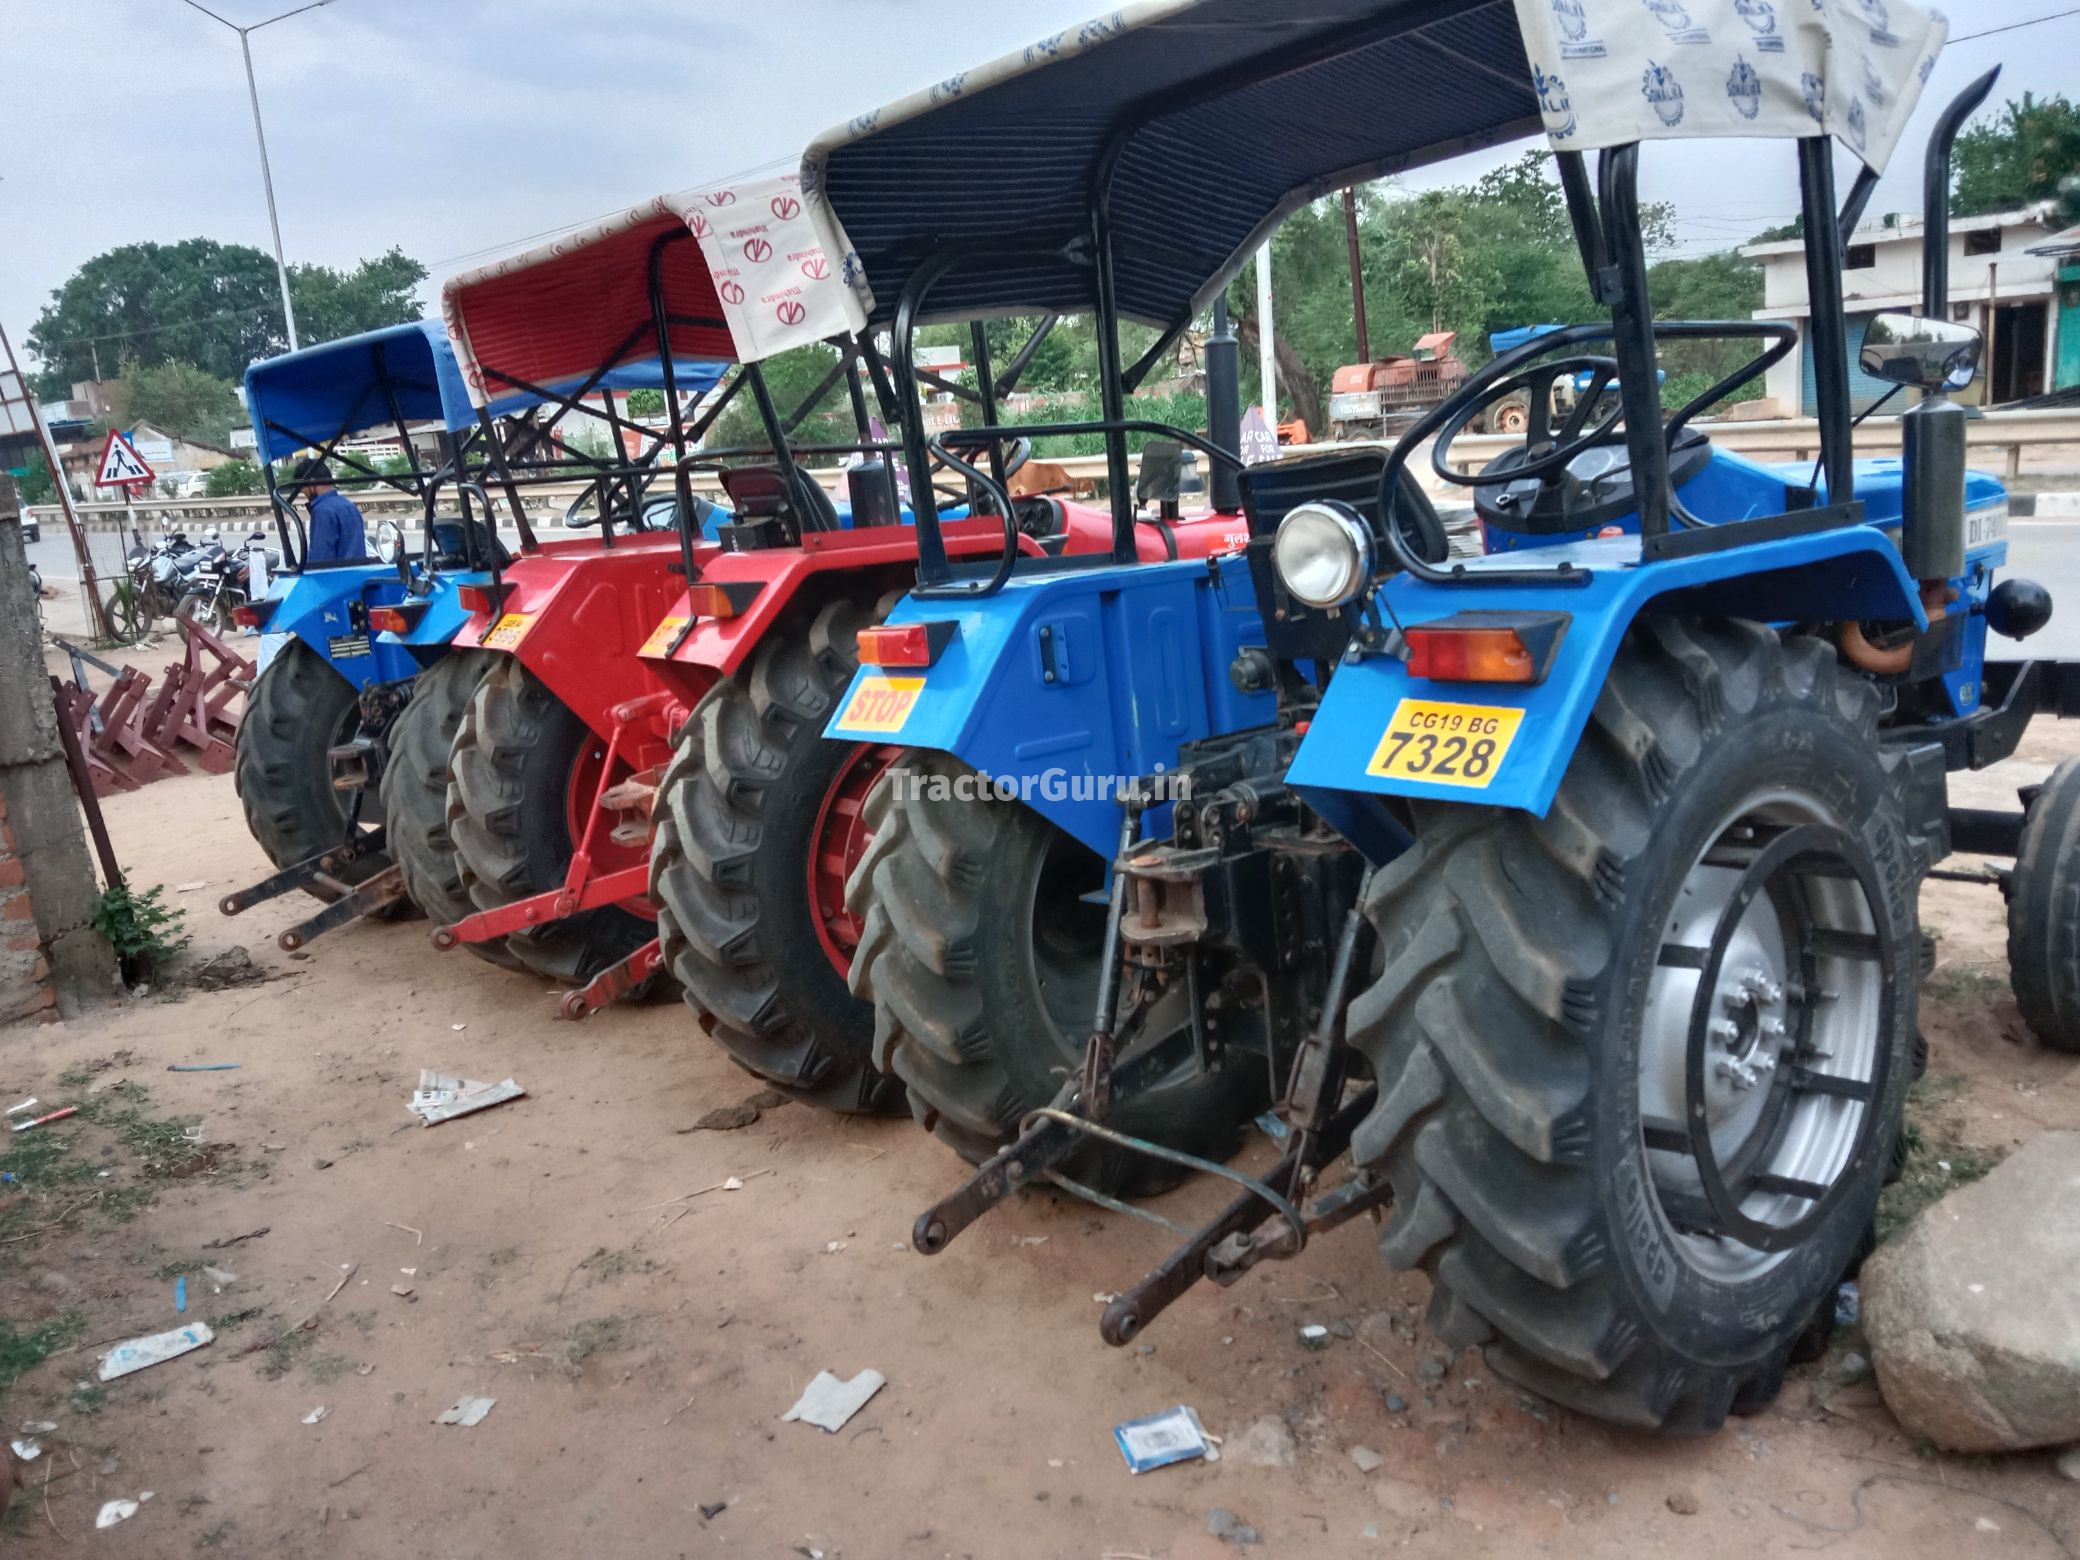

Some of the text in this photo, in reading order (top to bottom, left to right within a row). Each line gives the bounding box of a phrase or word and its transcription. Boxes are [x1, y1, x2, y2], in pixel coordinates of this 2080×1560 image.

[849, 690, 913, 722] STOP
[1410, 711, 1499, 734] CG19 BG
[1382, 731, 1496, 778] 7328
